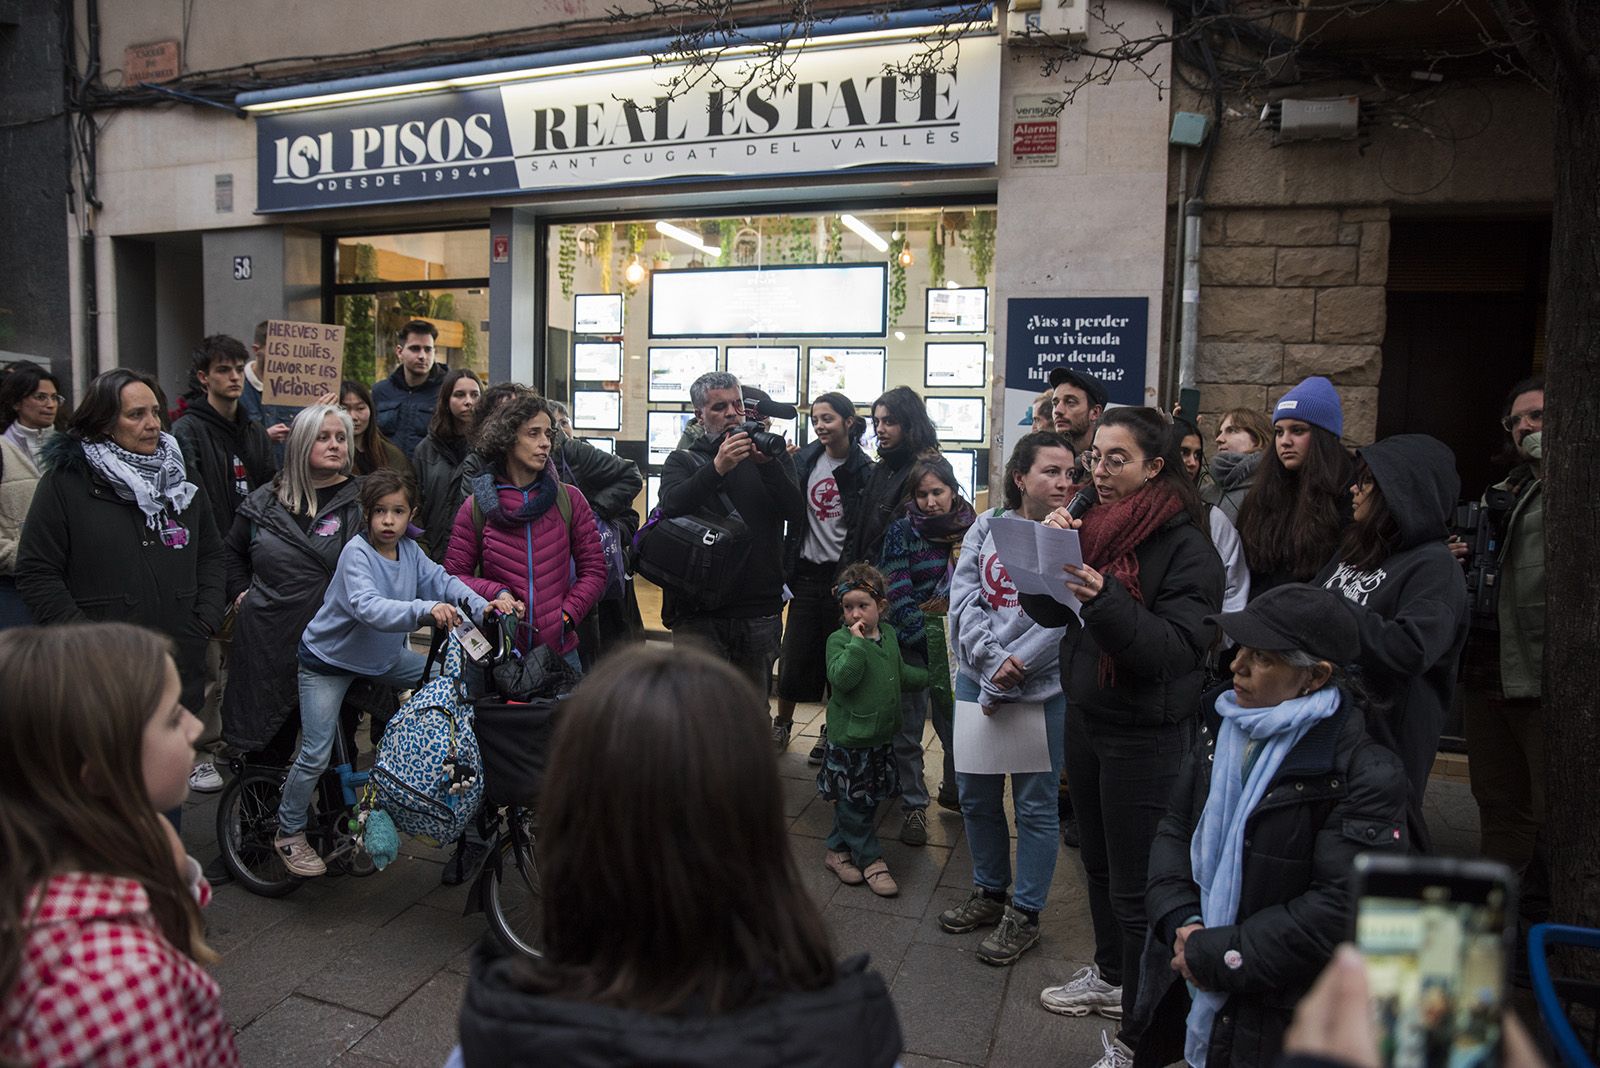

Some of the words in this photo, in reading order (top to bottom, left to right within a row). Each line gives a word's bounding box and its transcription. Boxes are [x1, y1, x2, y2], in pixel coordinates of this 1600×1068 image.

[533, 96, 688, 152] REAL
[705, 70, 960, 137] ESTATE
[1015, 124, 1056, 134] Alarma
[273, 131, 334, 179] 101
[350, 113, 494, 171] PISOS
[531, 157, 597, 171] SANT
[623, 147, 718, 165] CUGAT
[746, 141, 801, 156] DEL
[831, 130, 960, 150] VALLÈS
[328, 174, 401, 191] DESDE
[421, 166, 478, 183] 1994
[234, 257, 251, 279] 58
[1027, 314, 1059, 331] ¿Vas
[1061, 318, 1071, 328] a
[1074, 314, 1129, 331] perder
[325, 328, 340, 341] DE
[1033, 333, 1050, 346] tu
[1053, 332, 1120, 346] vivienda
[268, 342, 290, 357] LES
[1037, 353, 1065, 366] por
[1067, 350, 1116, 363] deuda
[267, 360, 303, 374] LLAVOR
[304, 363, 317, 375] DE
[319, 365, 337, 378] LES
